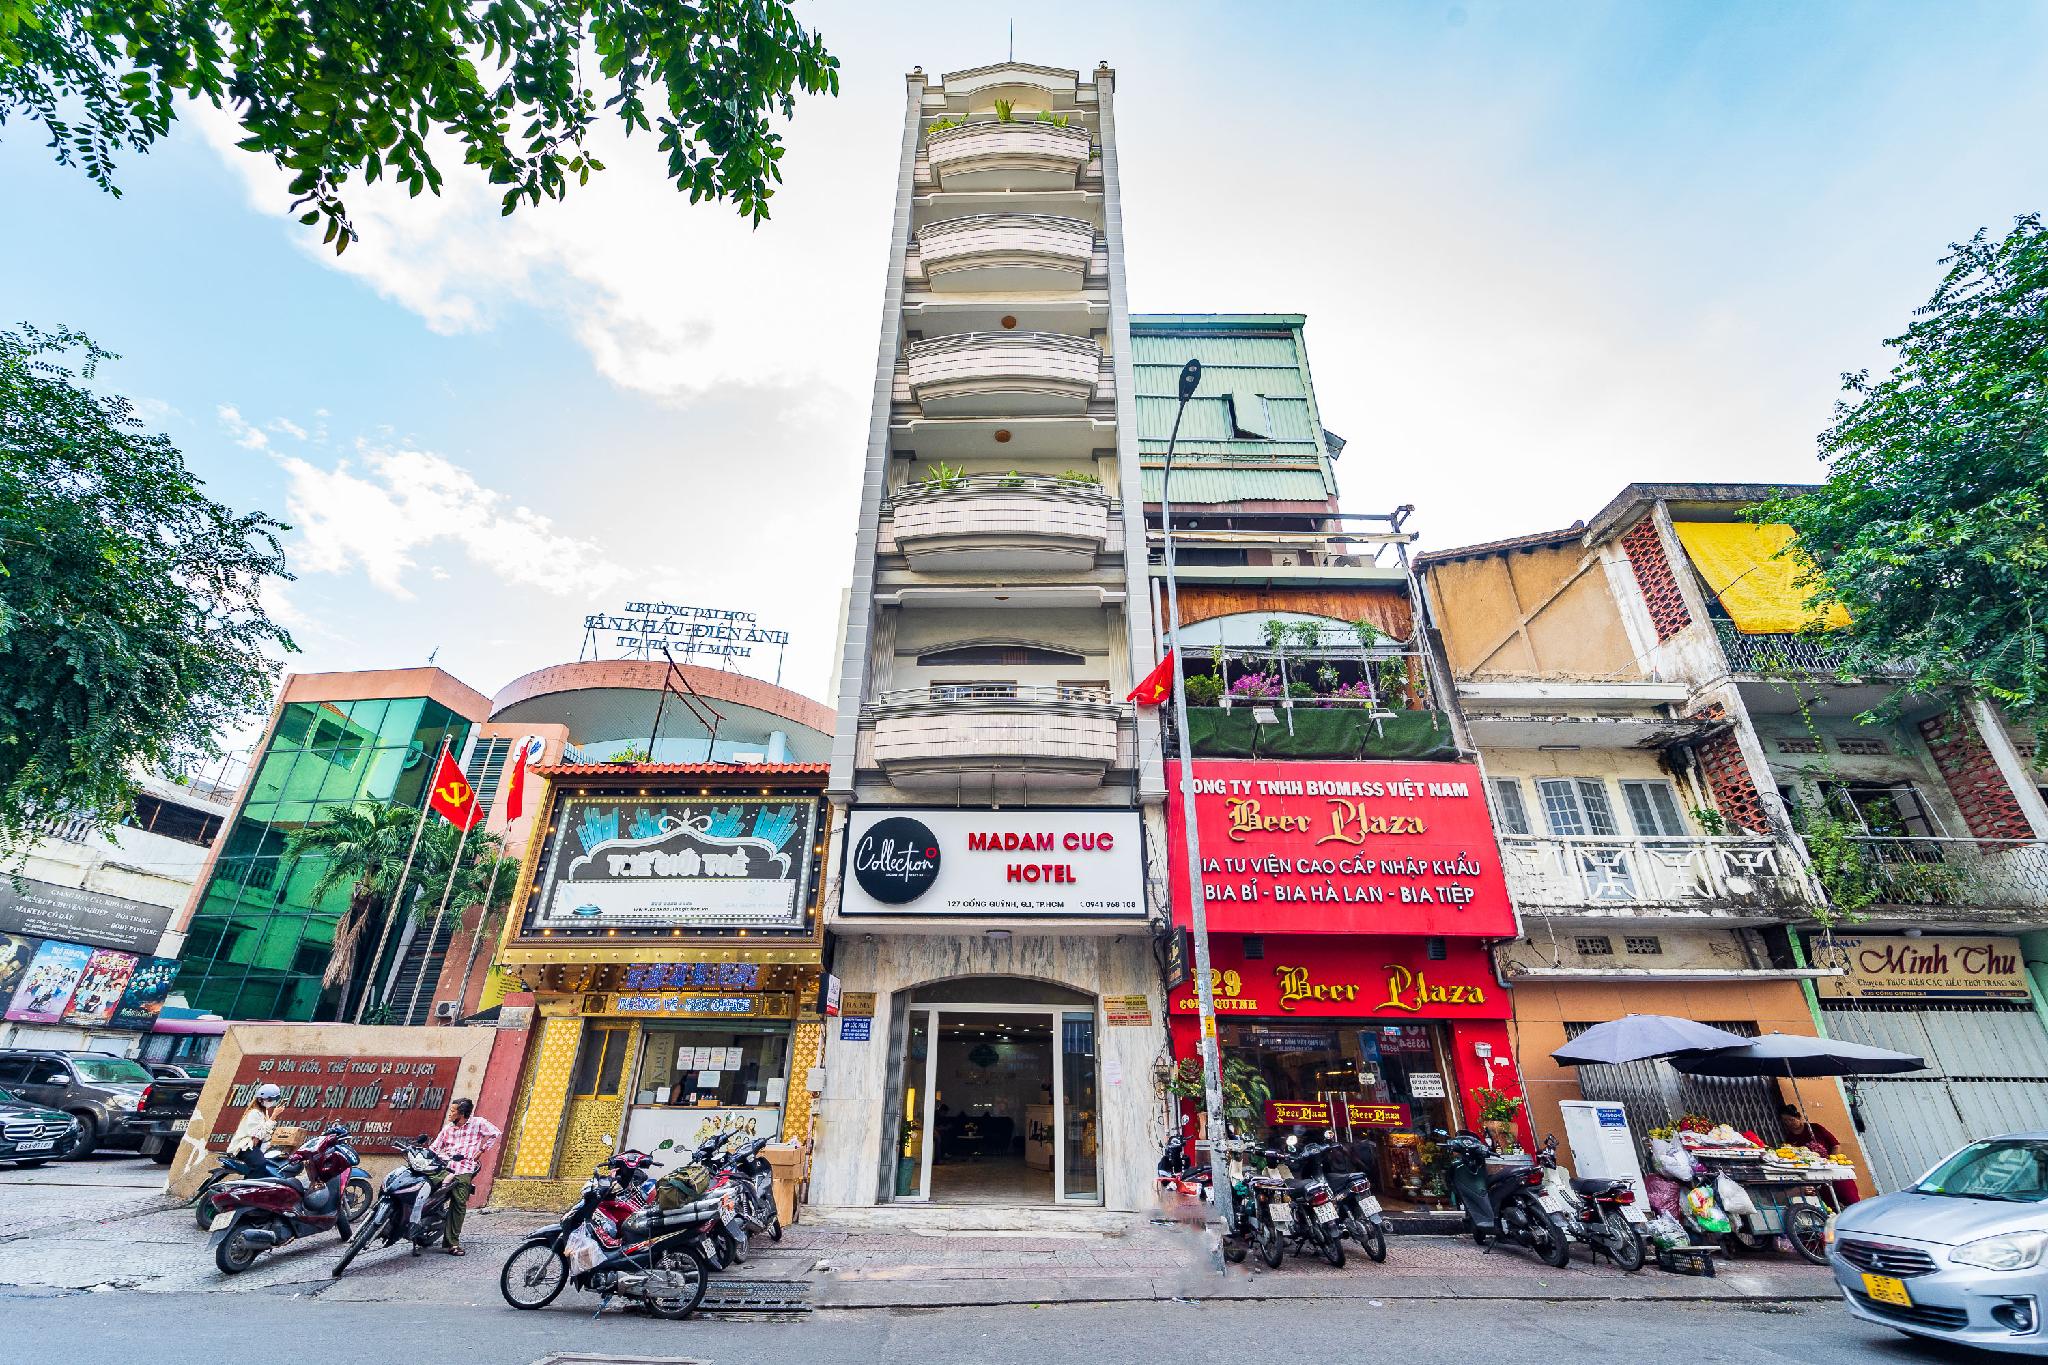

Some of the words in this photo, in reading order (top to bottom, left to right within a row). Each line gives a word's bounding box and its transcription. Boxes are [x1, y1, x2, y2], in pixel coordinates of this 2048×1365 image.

[745, 624, 789, 644] ẢNH
[709, 645, 751, 657] MINH
[1229, 779, 1252, 795] TY
[1256, 779, 1303, 796] TNHH
[1306, 780, 1384, 797] BIOMASS
[1386, 777, 1426, 801] VIỆT
[1429, 782, 1470, 798] NAM
[1225, 797, 1312, 842] Beer
[1315, 798, 1428, 845] Plaza
[968, 832, 1055, 851] MADAM
[1062, 832, 1114, 851] CUC
[857, 836, 934, 882] Collection
[1225, 857, 1246, 873] TU
[1250, 853, 1292, 877] VIỆN
[1297, 857, 1336, 874] CAO
[1339, 850, 1376, 875] CẤP
[1381, 856, 1428, 878] NHẬP
[1432, 850, 1481, 877] KHẨU
[1006, 863, 1077, 884] HOTEL
[947, 900, 961, 908] 127
[962, 898, 987, 908] CỐNG
[1205, 884, 1236, 901] BIA
[1241, 877, 1258, 901] BỈ
[1275, 885, 1307, 902] BIA
[1310, 880, 1341, 902] HÀ
[1343, 887, 1383, 903] LAN
[1401, 886, 1434, 904] BIA
[1436, 882, 1475, 910] TIỆP
[1859, 943, 1949, 975] Minh
[1953, 943, 2016, 975] Thu
[1276, 965, 1359, 1011] Beer
[1372, 964, 1487, 1012] Plaza
[259, 1060, 275, 1074] BỘ
[351, 1062, 378, 1074] THAO
[395, 1062, 411, 1075] DU
[412, 1063, 437, 1077] LỊCH
[294, 1085, 322, 1112] HỌC
[347, 1078, 383, 1109] KHẤU
[419, 1078, 447, 1110] ẢNH
[1276, 1107, 1298, 1118] Beer
[1349, 1108, 1372, 1120] Beer
[363, 1121, 393, 1133] MINH
[209, 1133, 226, 1143] THE
[350, 1136, 361, 1146] OF
[362, 1136, 375, 1146] HO
